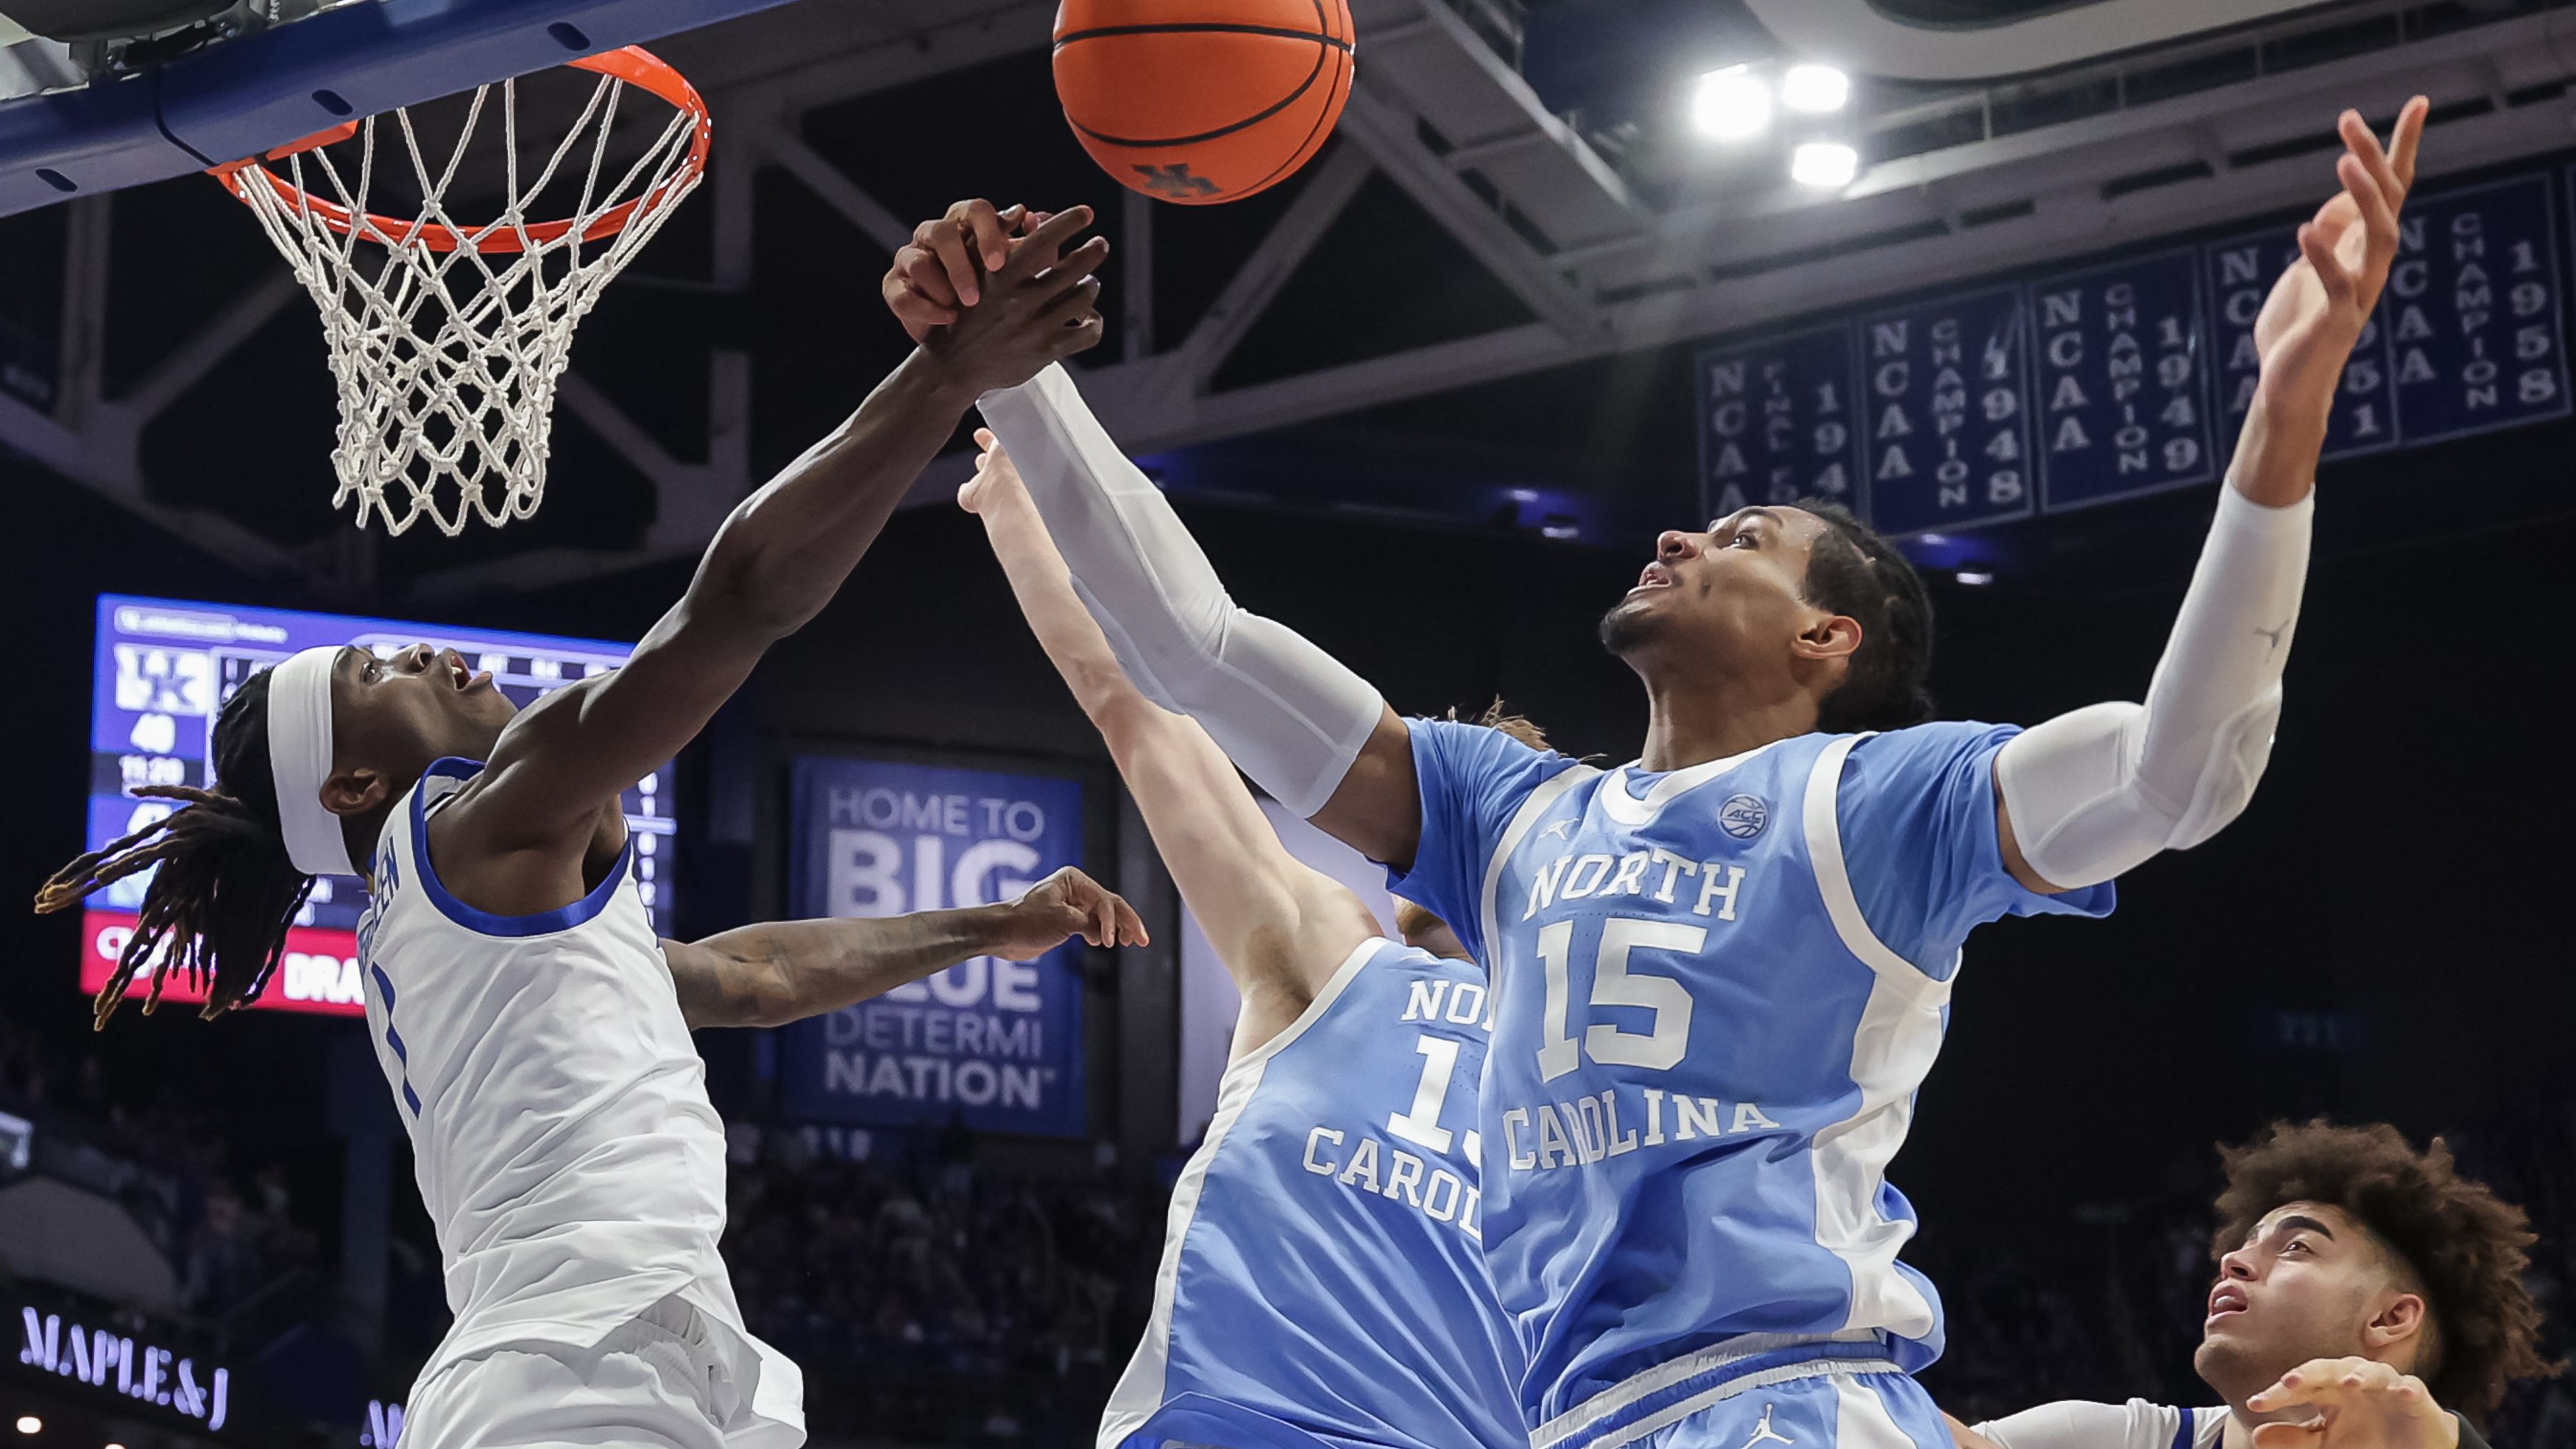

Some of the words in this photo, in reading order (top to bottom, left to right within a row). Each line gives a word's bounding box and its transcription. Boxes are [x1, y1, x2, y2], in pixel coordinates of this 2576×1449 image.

[1872, 319, 1915, 481] NCAA
[2042, 290, 2091, 452] NCAA
[2156, 315, 2199, 471] 1949
[2510, 240, 2555, 404] 1958
[827, 828, 1041, 918] BIG
[829, 786, 972, 836] HOME
[979, 797, 1045, 843] TO
[1521, 848, 1747, 921] NORTH
[1537, 917, 1708, 1083] 15
